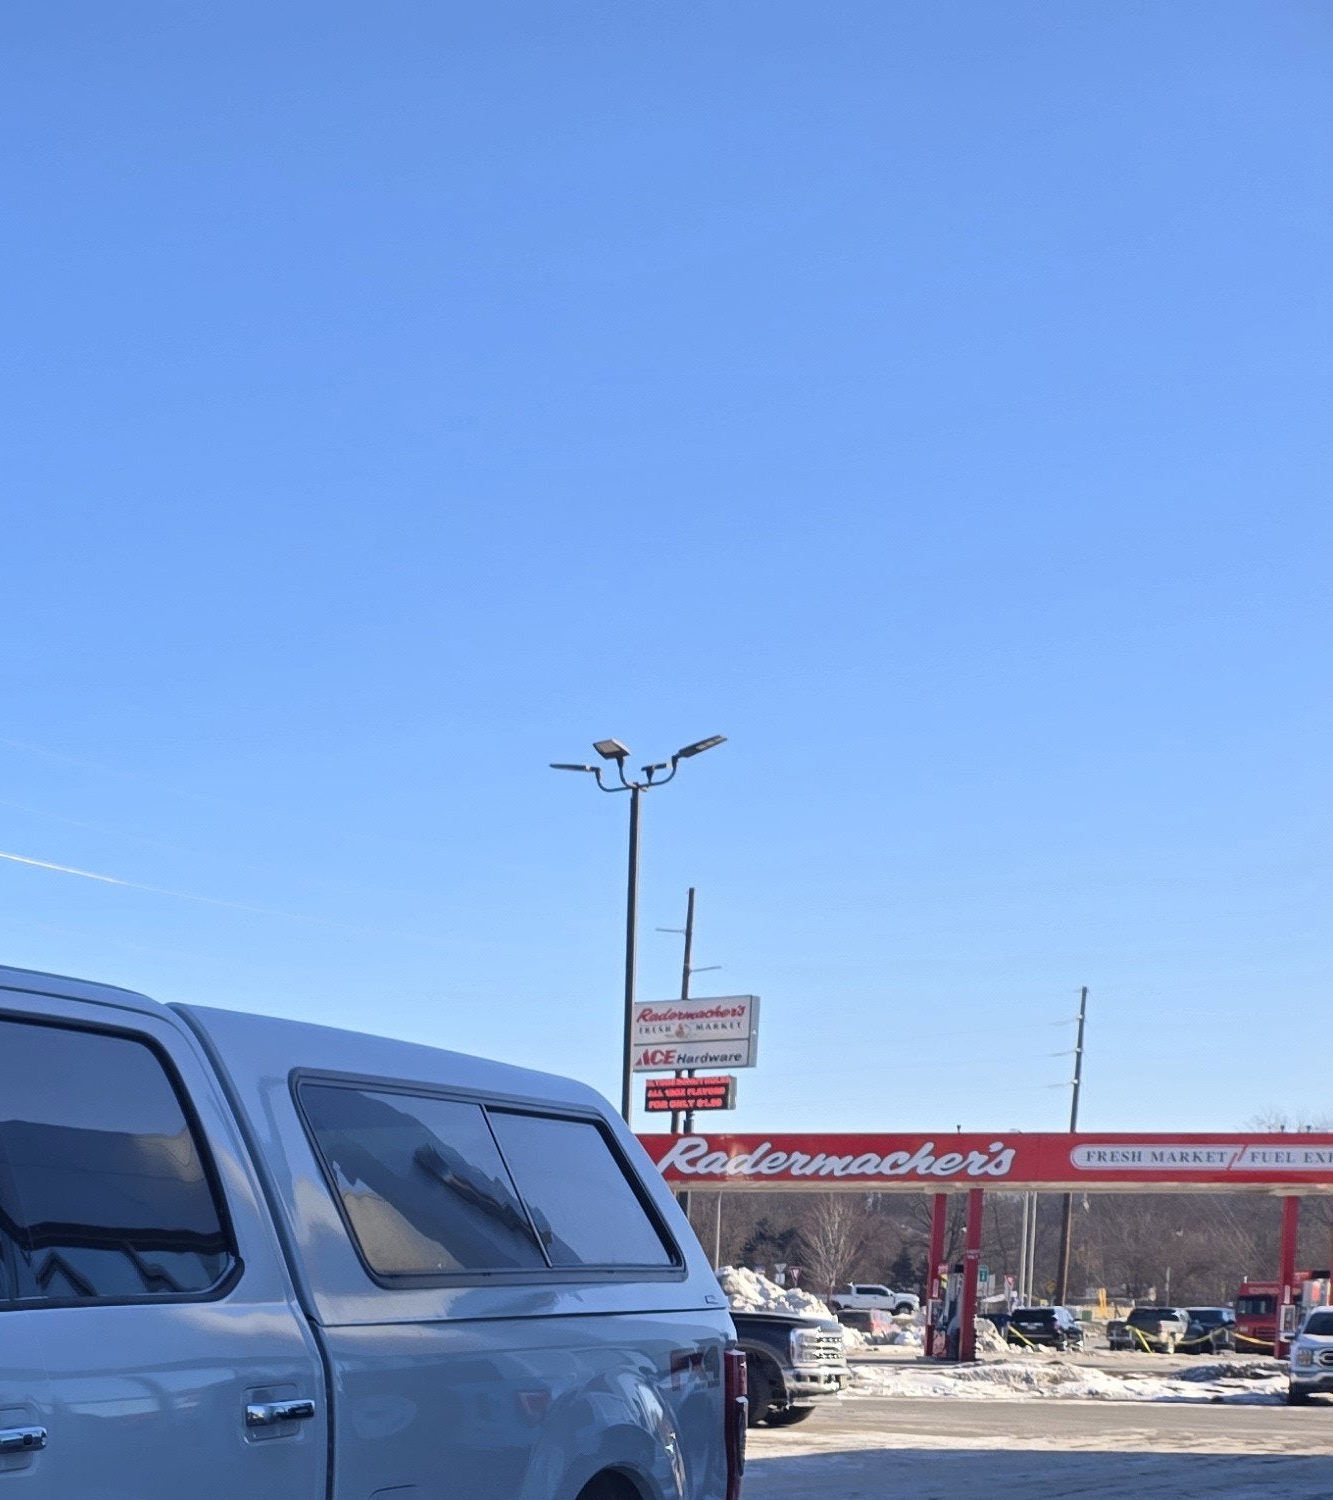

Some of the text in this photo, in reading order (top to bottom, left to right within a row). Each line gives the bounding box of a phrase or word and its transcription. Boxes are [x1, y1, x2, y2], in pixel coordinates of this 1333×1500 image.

[636, 1004, 746, 1023] Radermacher's
[639, 1021, 741, 1035] FRESH MARKET
[635, 1049, 743, 1067] ACE Hardware
[659, 1136, 1017, 1177] Radermacher's
[1085, 1151, 1142, 1163] FRESH
[1150, 1151, 1228, 1163] MARKET
[1250, 1151, 1297, 1163] FUEL
